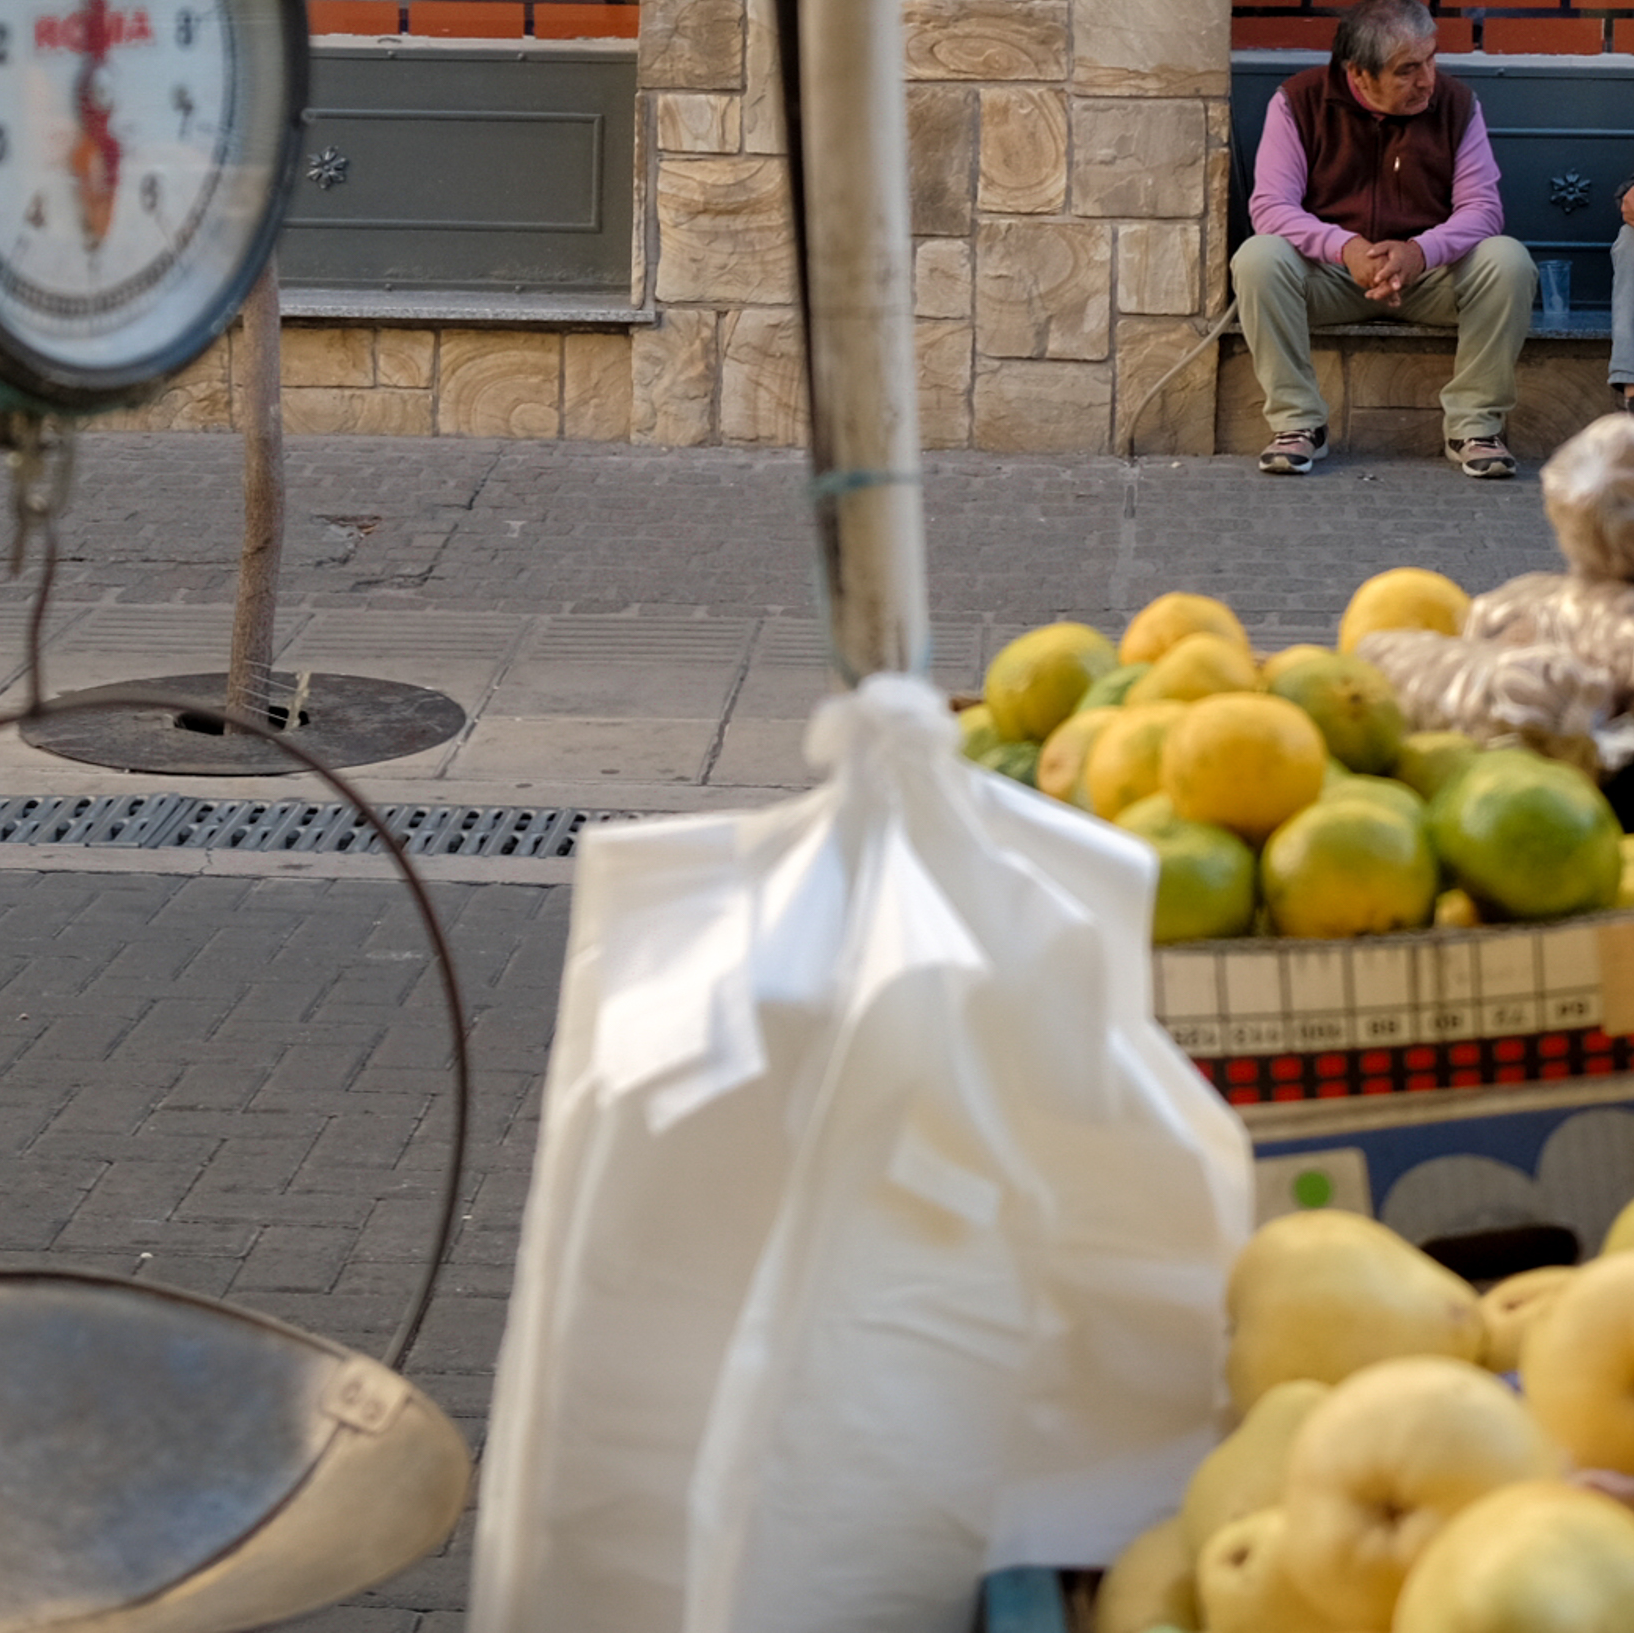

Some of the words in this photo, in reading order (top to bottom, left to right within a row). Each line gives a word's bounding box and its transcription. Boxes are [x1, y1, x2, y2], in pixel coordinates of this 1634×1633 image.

[176, 6, 196, 50] 8
[172, 84, 195, 139] 7
[25, 193, 48, 232] 4
[139, 173, 160, 214] 6
